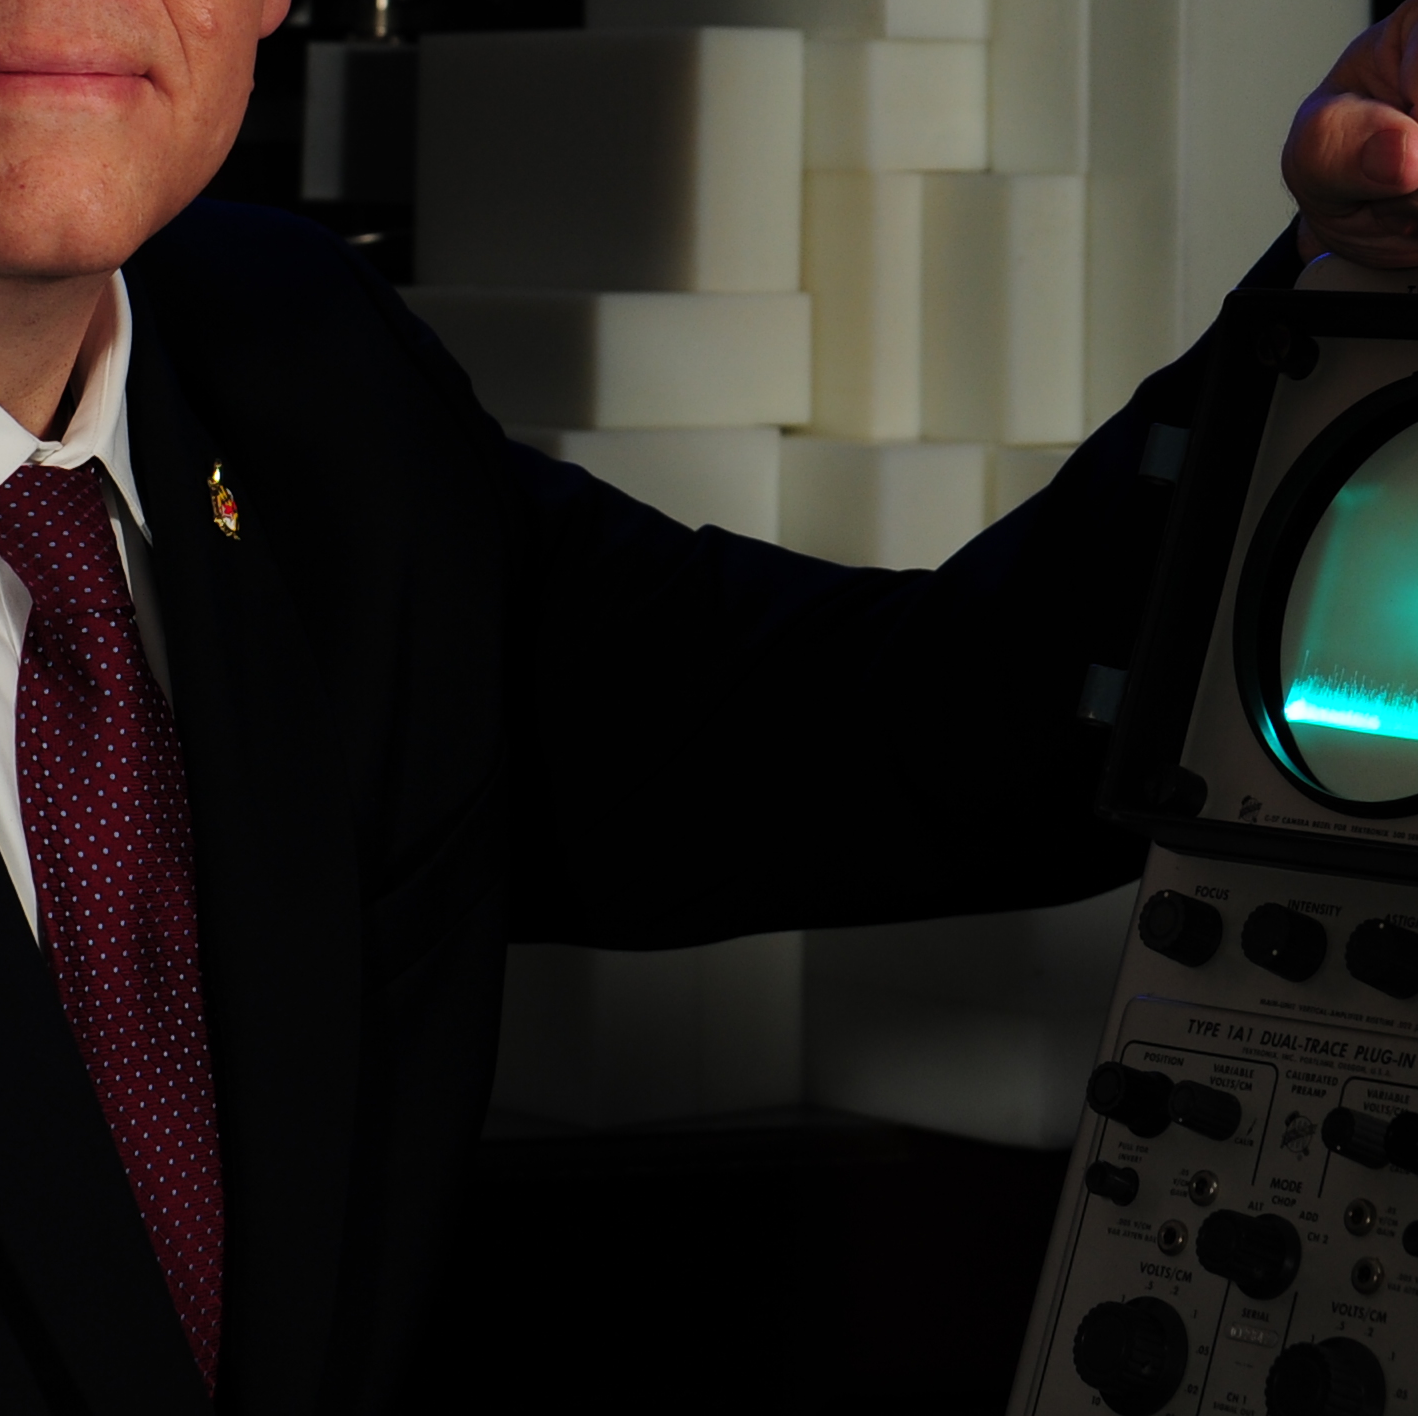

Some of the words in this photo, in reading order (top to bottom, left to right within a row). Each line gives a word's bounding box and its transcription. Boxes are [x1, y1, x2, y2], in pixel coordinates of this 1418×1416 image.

[1282, 816, 1310, 828] CAMERA
[1194, 884, 1230, 901] FOCUS
[1287, 898, 1343, 918] INTENSITY
[1187, 1018, 1222, 1038] TYPE
[1226, 1024, 1254, 1043] 1A1
[1259, 1030, 1349, 1059] DUAL-TRACE
[1354, 1045, 1417, 1069] PLUG-IN
[1143, 1051, 1185, 1067] POSITION
[1213, 1063, 1255, 1079] VARIABLE
[1285, 1069, 1339, 1087] CALIBRATED
[1209, 1075, 1253, 1091] VOLTS/CM
[1291, 1084, 1327, 1098] PREAMP
[1367, 1088, 1411, 1105] VARIABLE
[1269, 1177, 1304, 1194] MODE
[1247, 1200, 1265, 1212] ALT
[1271, 1194, 1297, 1208] CHOP
[1298, 1210, 1320, 1223] ADD
[1306, 1231, 1321, 1243] CH
[1139, 1261, 1193, 1283] VOLTS/CM
[1241, 1307, 1270, 1323] SERIAL
[1331, 1300, 1388, 1325] VOLTS/CM
[1226, 1391, 1240, 1403] CH
